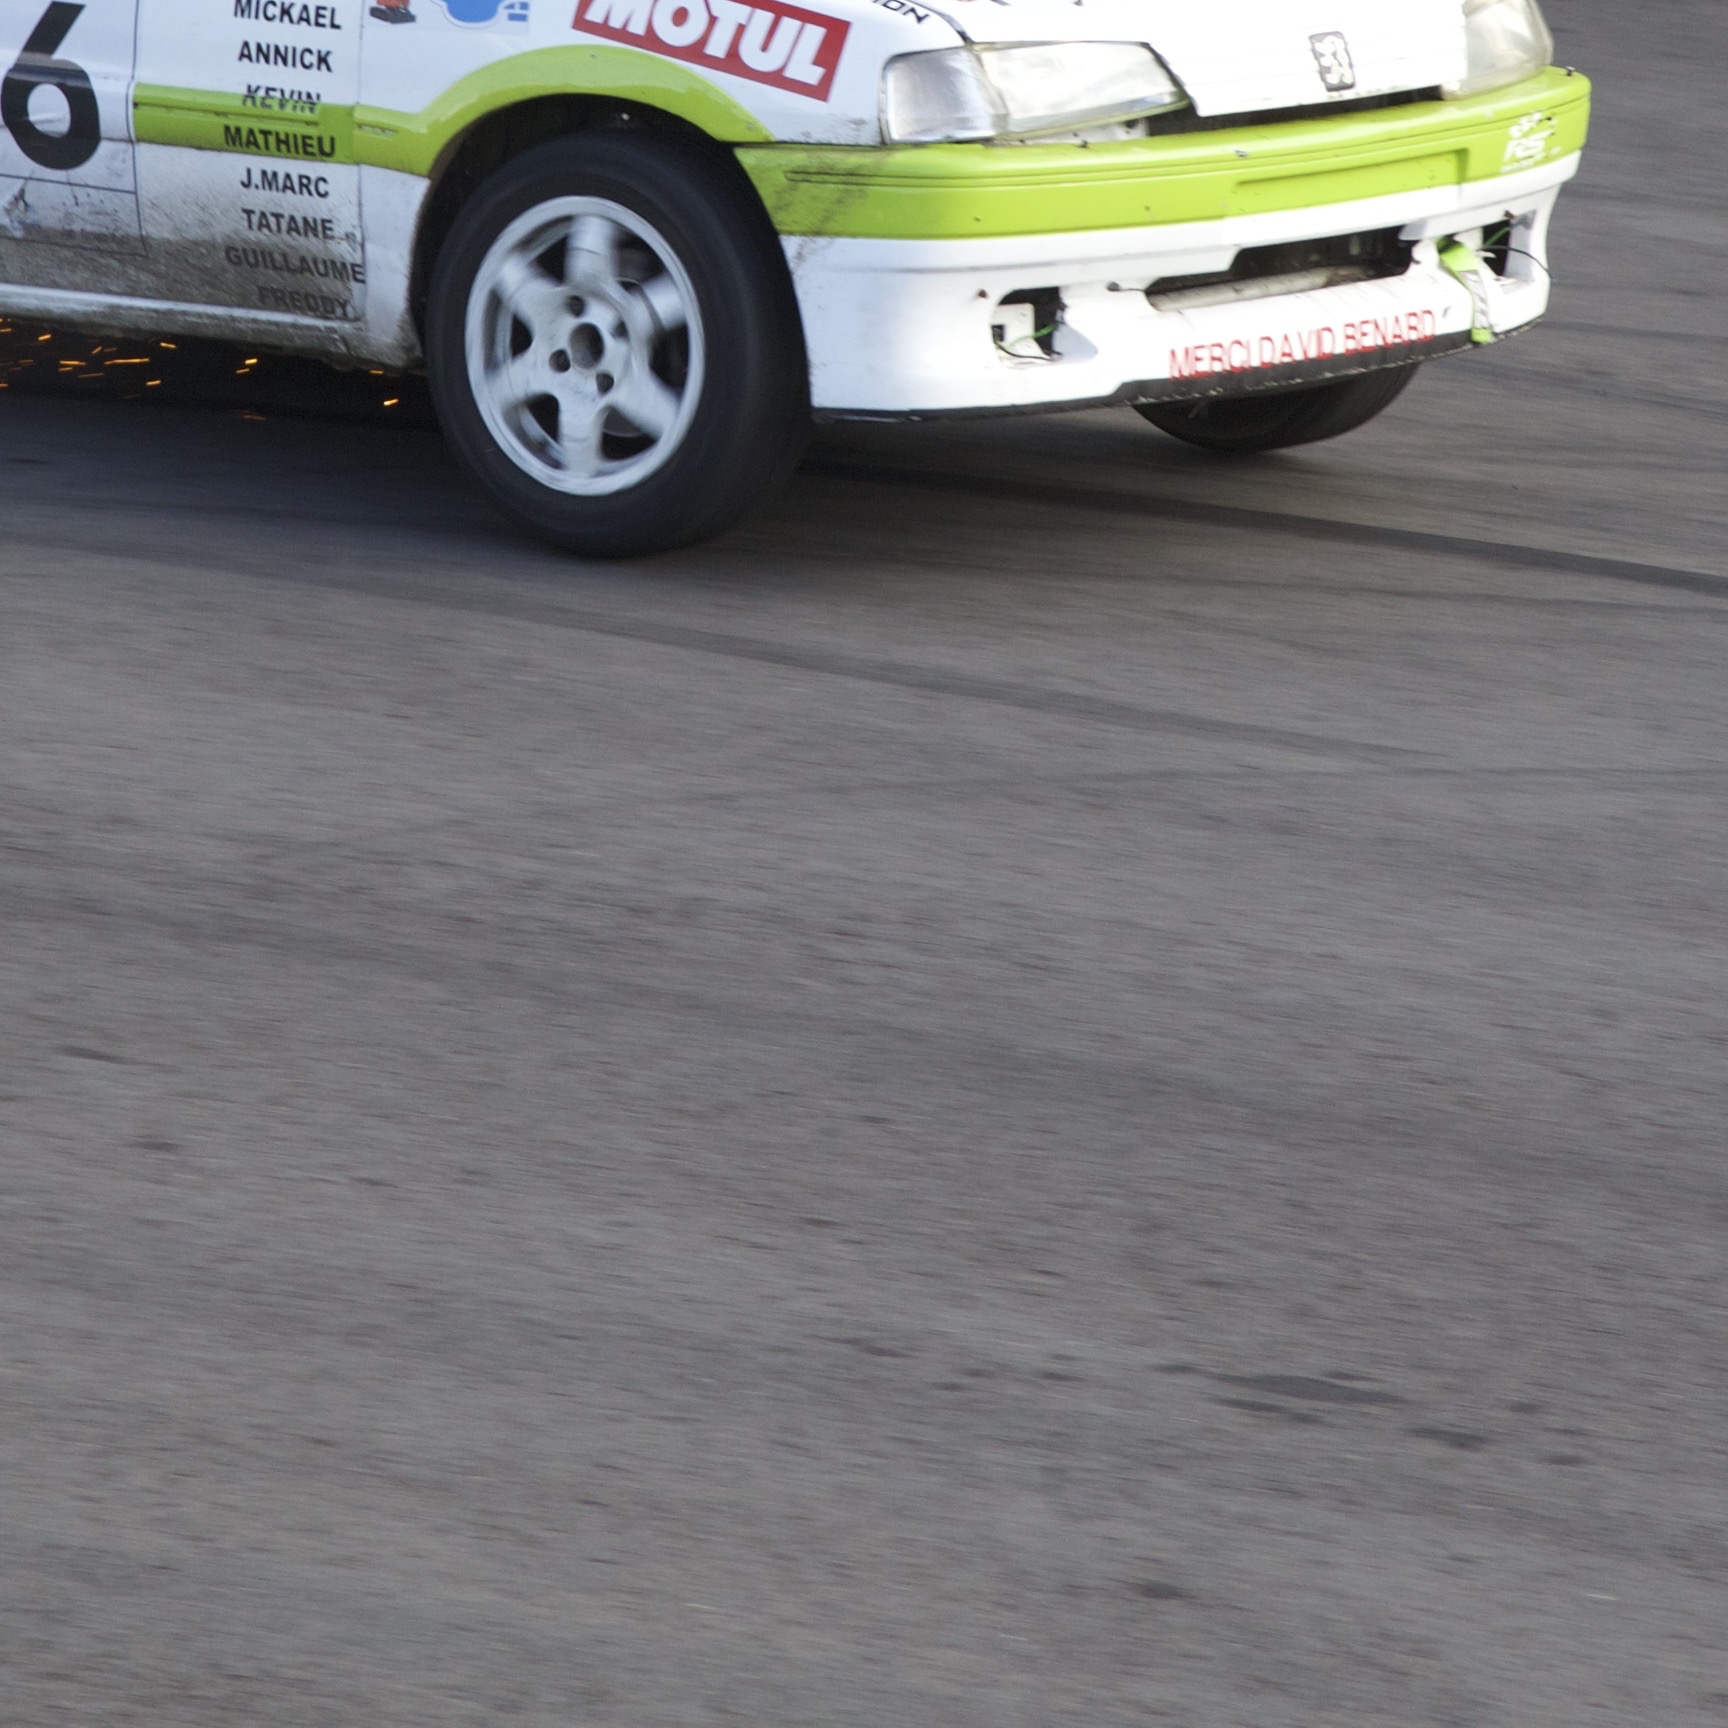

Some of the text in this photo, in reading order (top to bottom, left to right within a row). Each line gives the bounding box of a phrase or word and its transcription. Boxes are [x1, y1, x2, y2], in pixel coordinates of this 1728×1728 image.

[237, 39, 334, 74] ANNICK
[241, 83, 321, 115] KEVIN
[223, 124, 336, 159] MATHIEU
[240, 166, 330, 199] J.MARC
[241, 207, 336, 241] TATANE
[223, 244, 367, 285] GUILLAUME
[256, 284, 351, 319] FREDDY
[1168, 308, 1437, 382] MERCI DAVID BENARD
